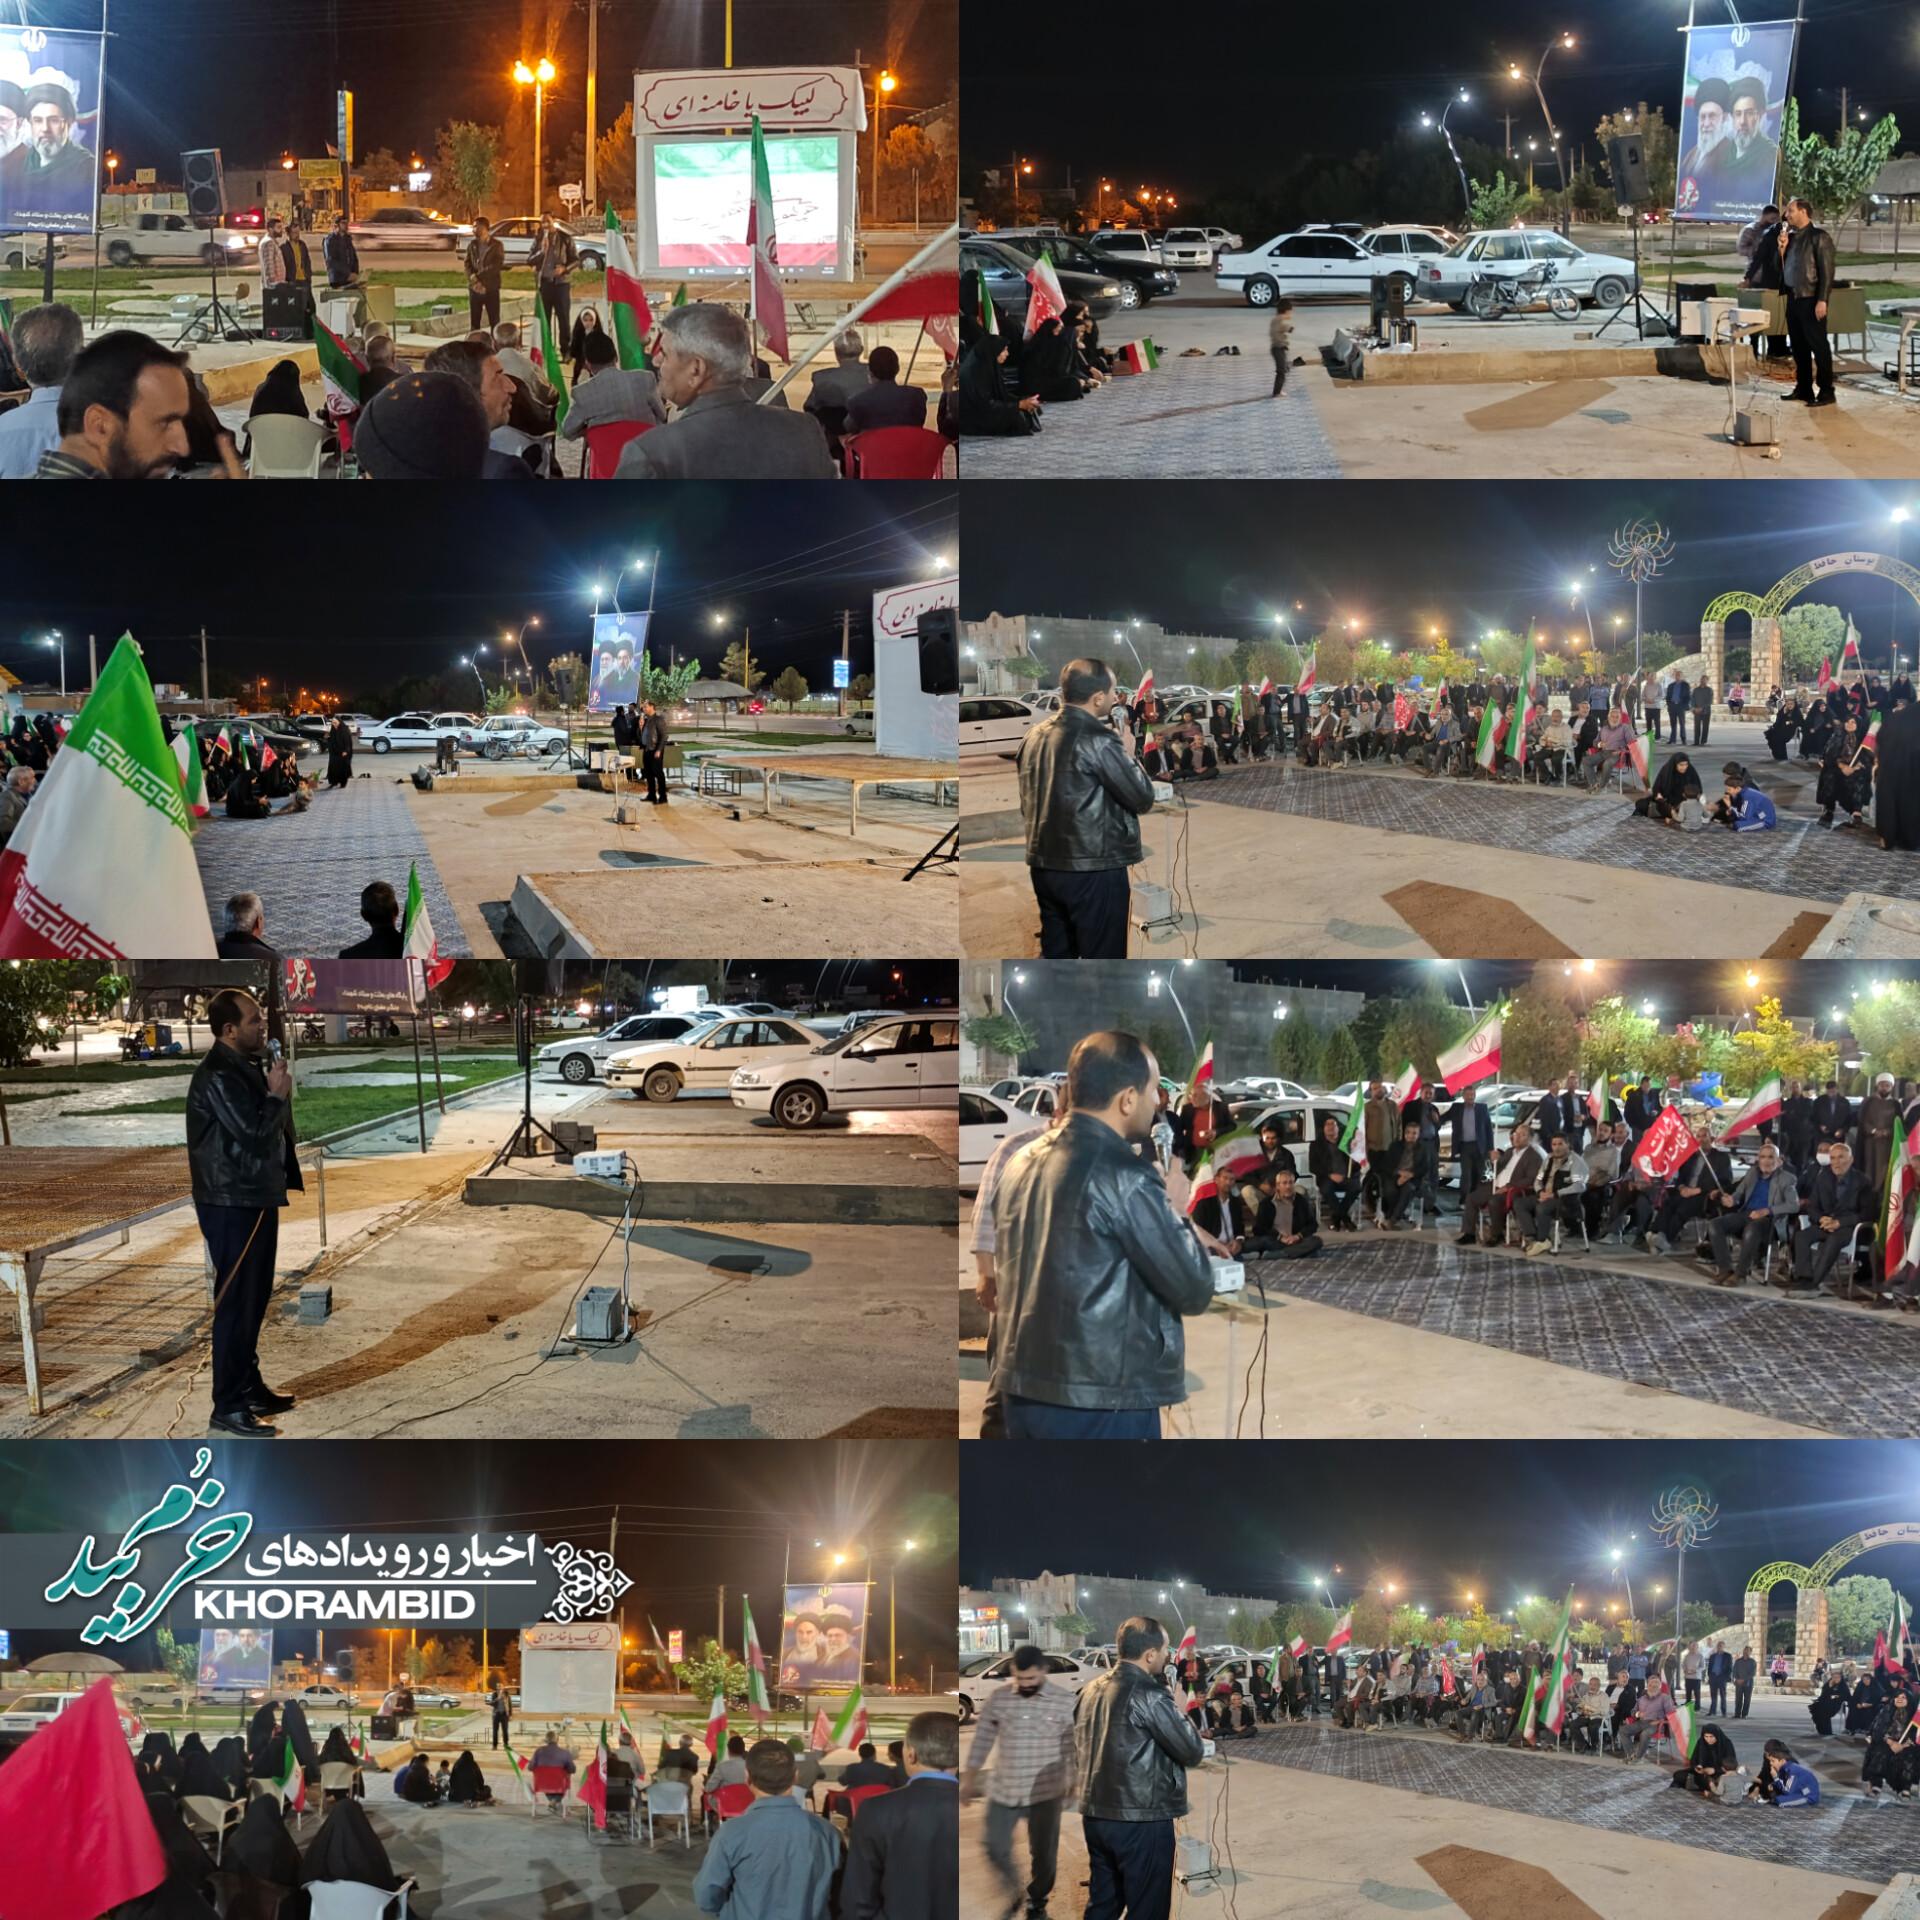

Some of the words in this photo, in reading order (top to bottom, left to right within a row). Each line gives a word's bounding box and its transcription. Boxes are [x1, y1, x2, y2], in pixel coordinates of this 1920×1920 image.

[663, 95, 695, 120] ای
[698, 89, 741, 114] خامنه
[743, 91, 754, 118] یا
[758, 76, 826, 116] لبیک
[574, 1627, 602, 1644] لبیک
